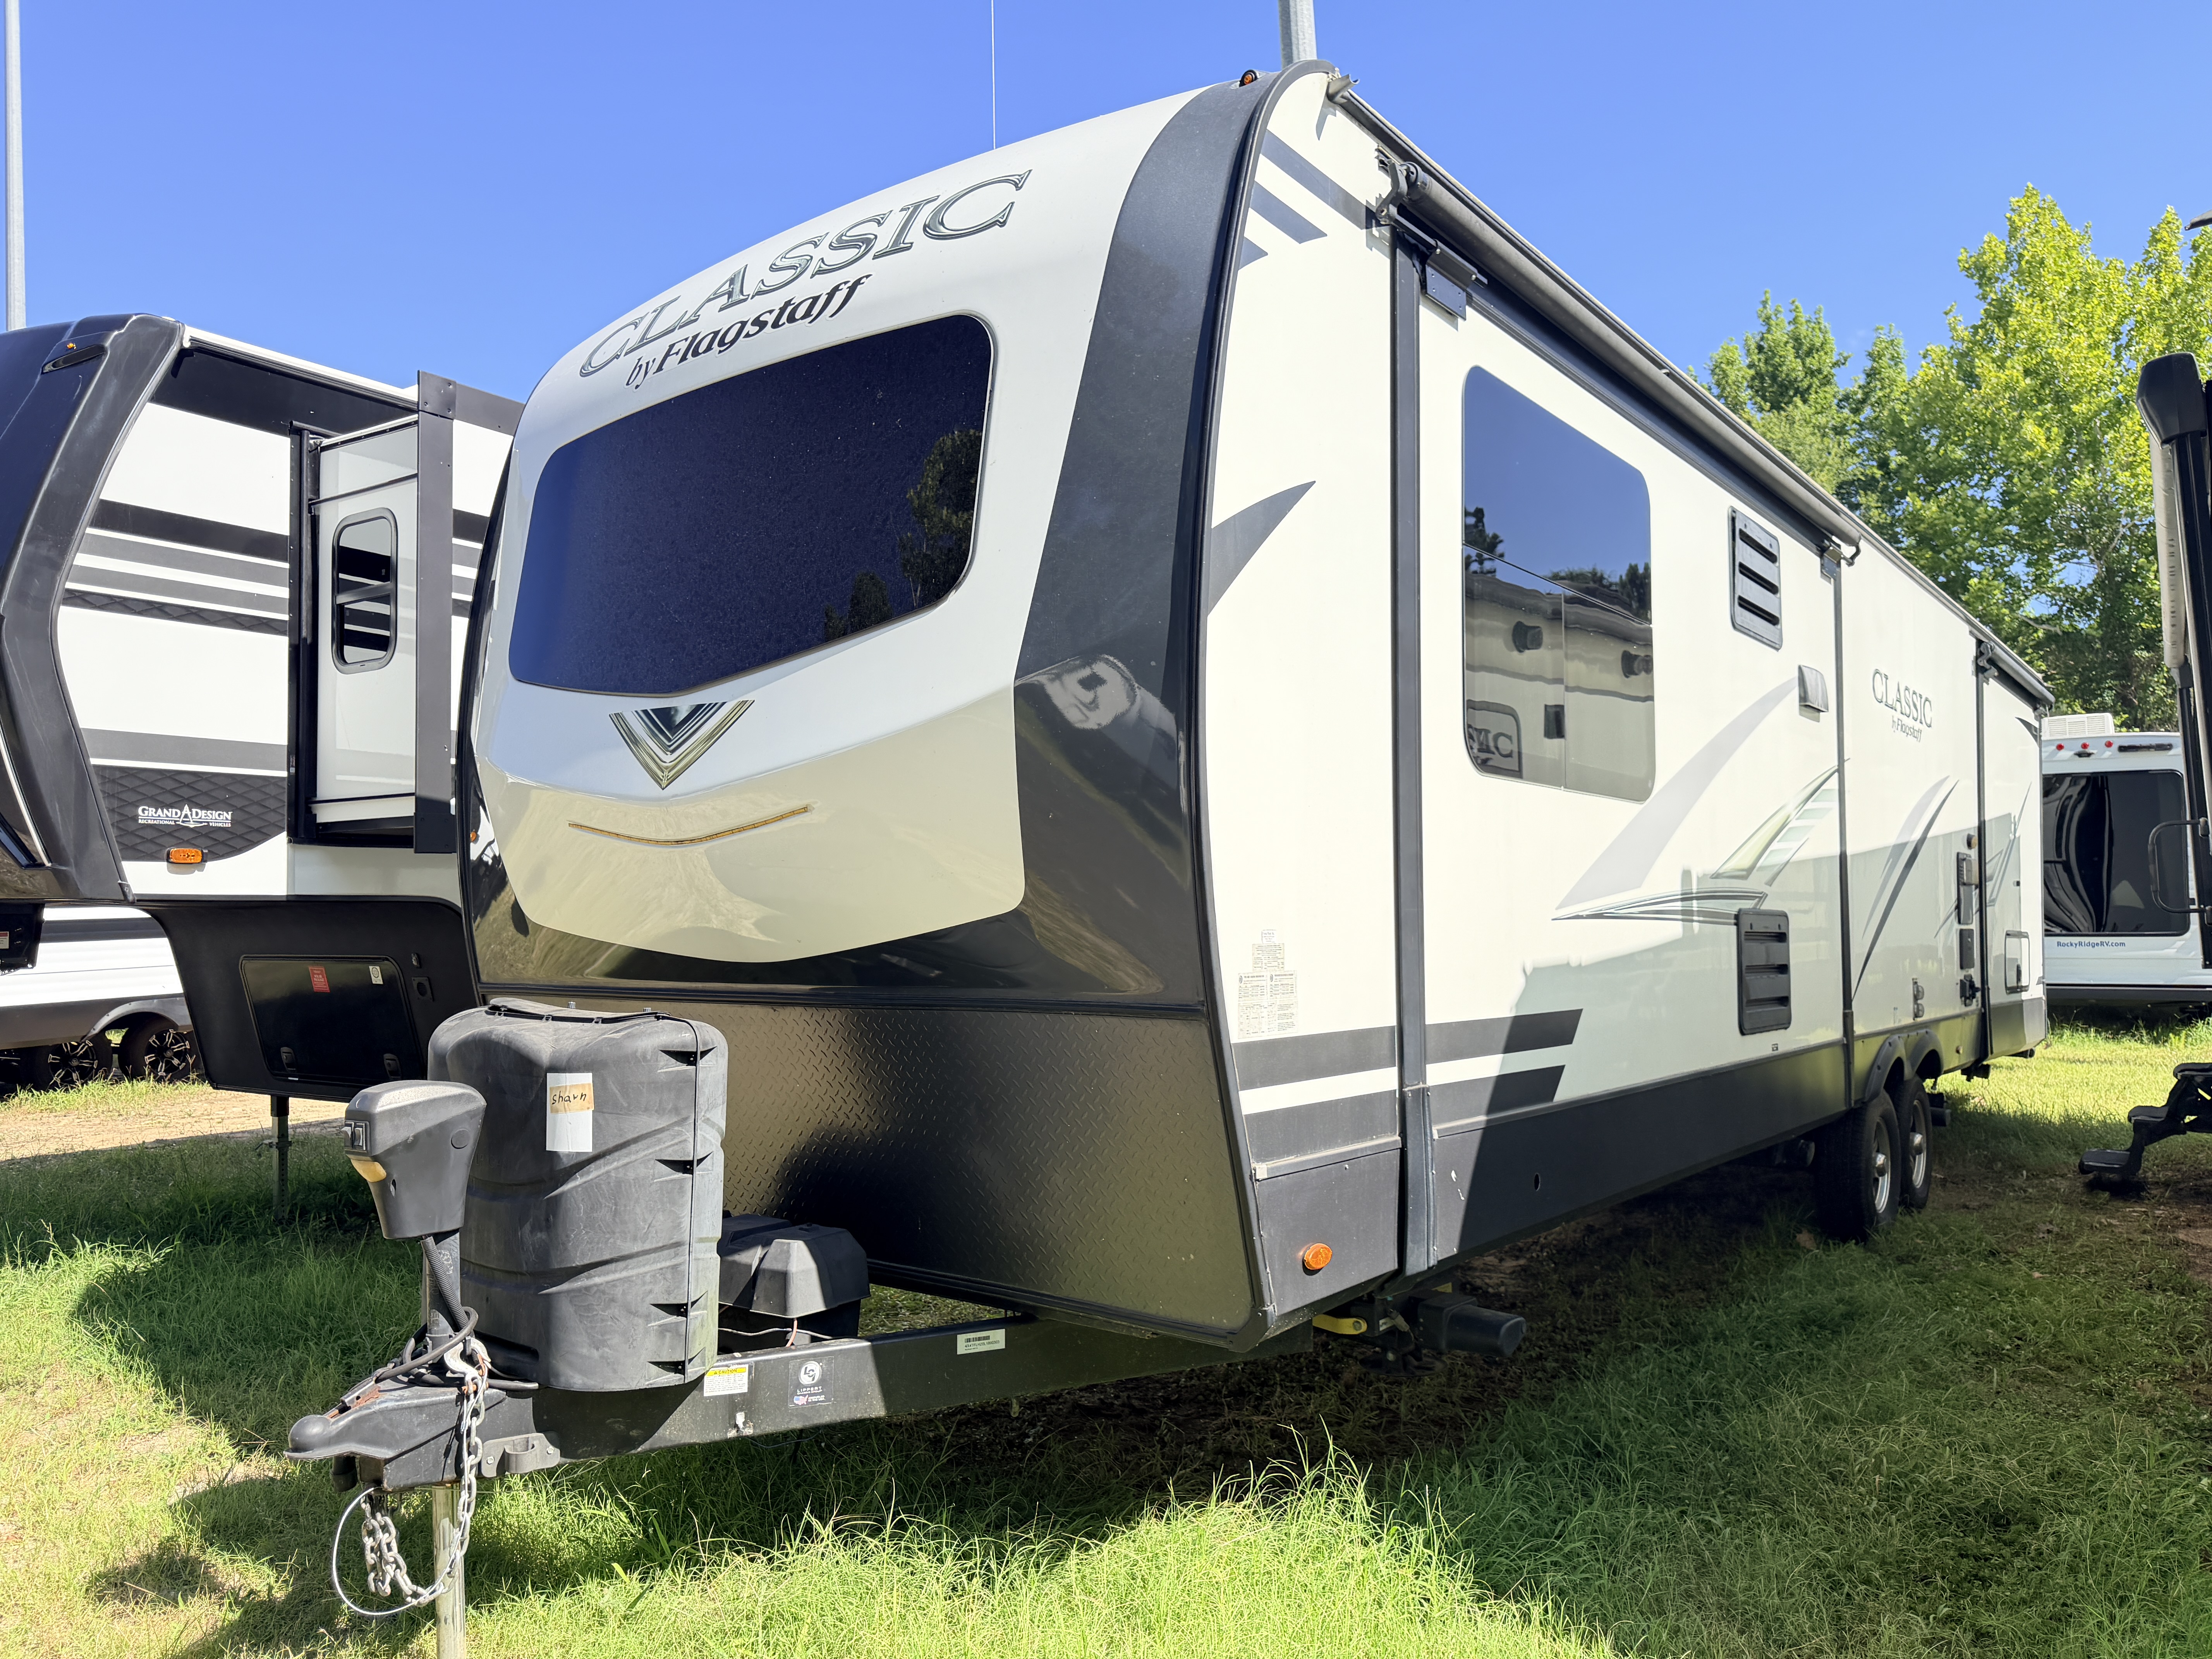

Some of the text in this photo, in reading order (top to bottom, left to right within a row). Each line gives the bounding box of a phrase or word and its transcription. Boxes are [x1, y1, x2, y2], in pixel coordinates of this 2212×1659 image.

[579, 170, 1032, 378] CLASSIC
[625, 274, 872, 390] by Flagstaff
[1872, 669, 1932, 727] CLASSIC
[1896, 718, 1922, 742] Flagstaff
[138, 806, 233, 820] GRAND DESIGN
